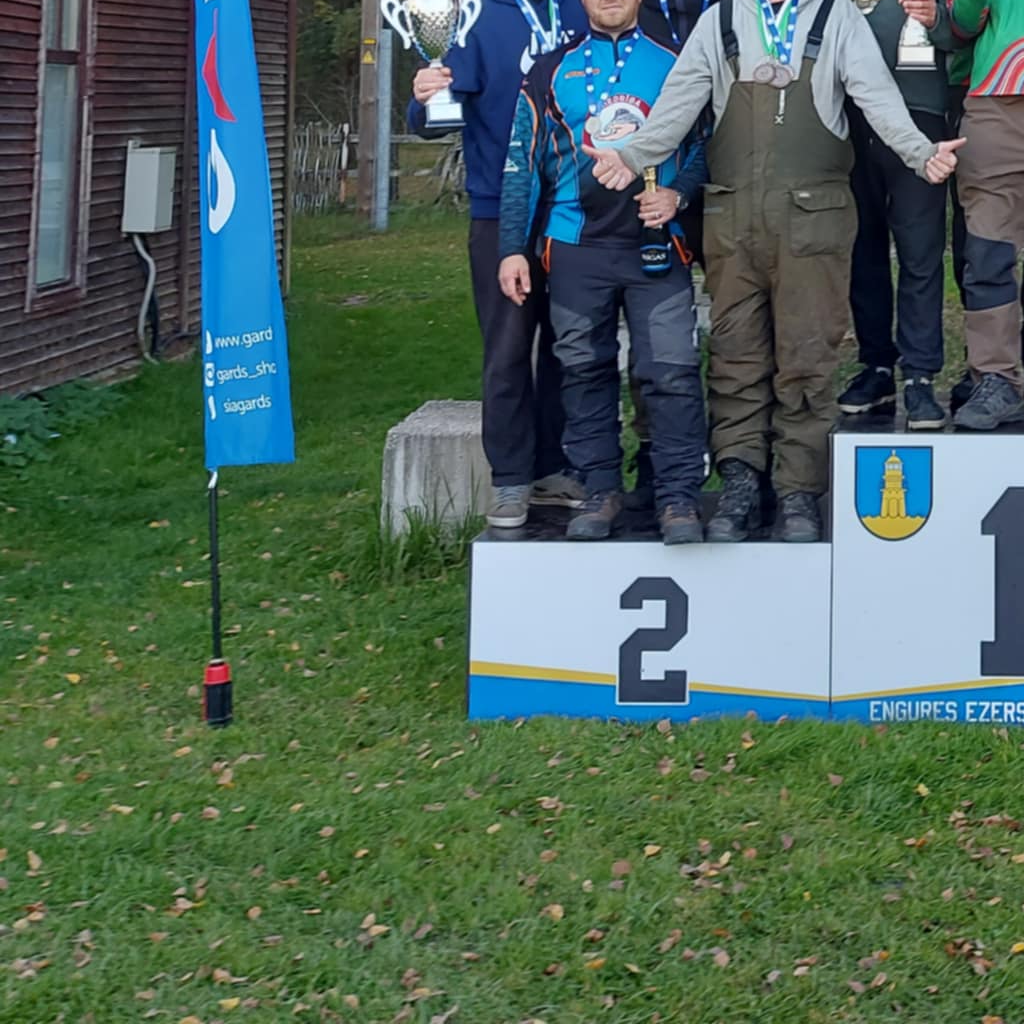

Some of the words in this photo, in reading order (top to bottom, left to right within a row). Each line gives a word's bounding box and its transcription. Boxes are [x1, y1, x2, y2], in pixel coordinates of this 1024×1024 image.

[223, 394, 272, 416] siagards
[618, 576, 688, 704] 2
[869, 699, 957, 722] ENGURES
